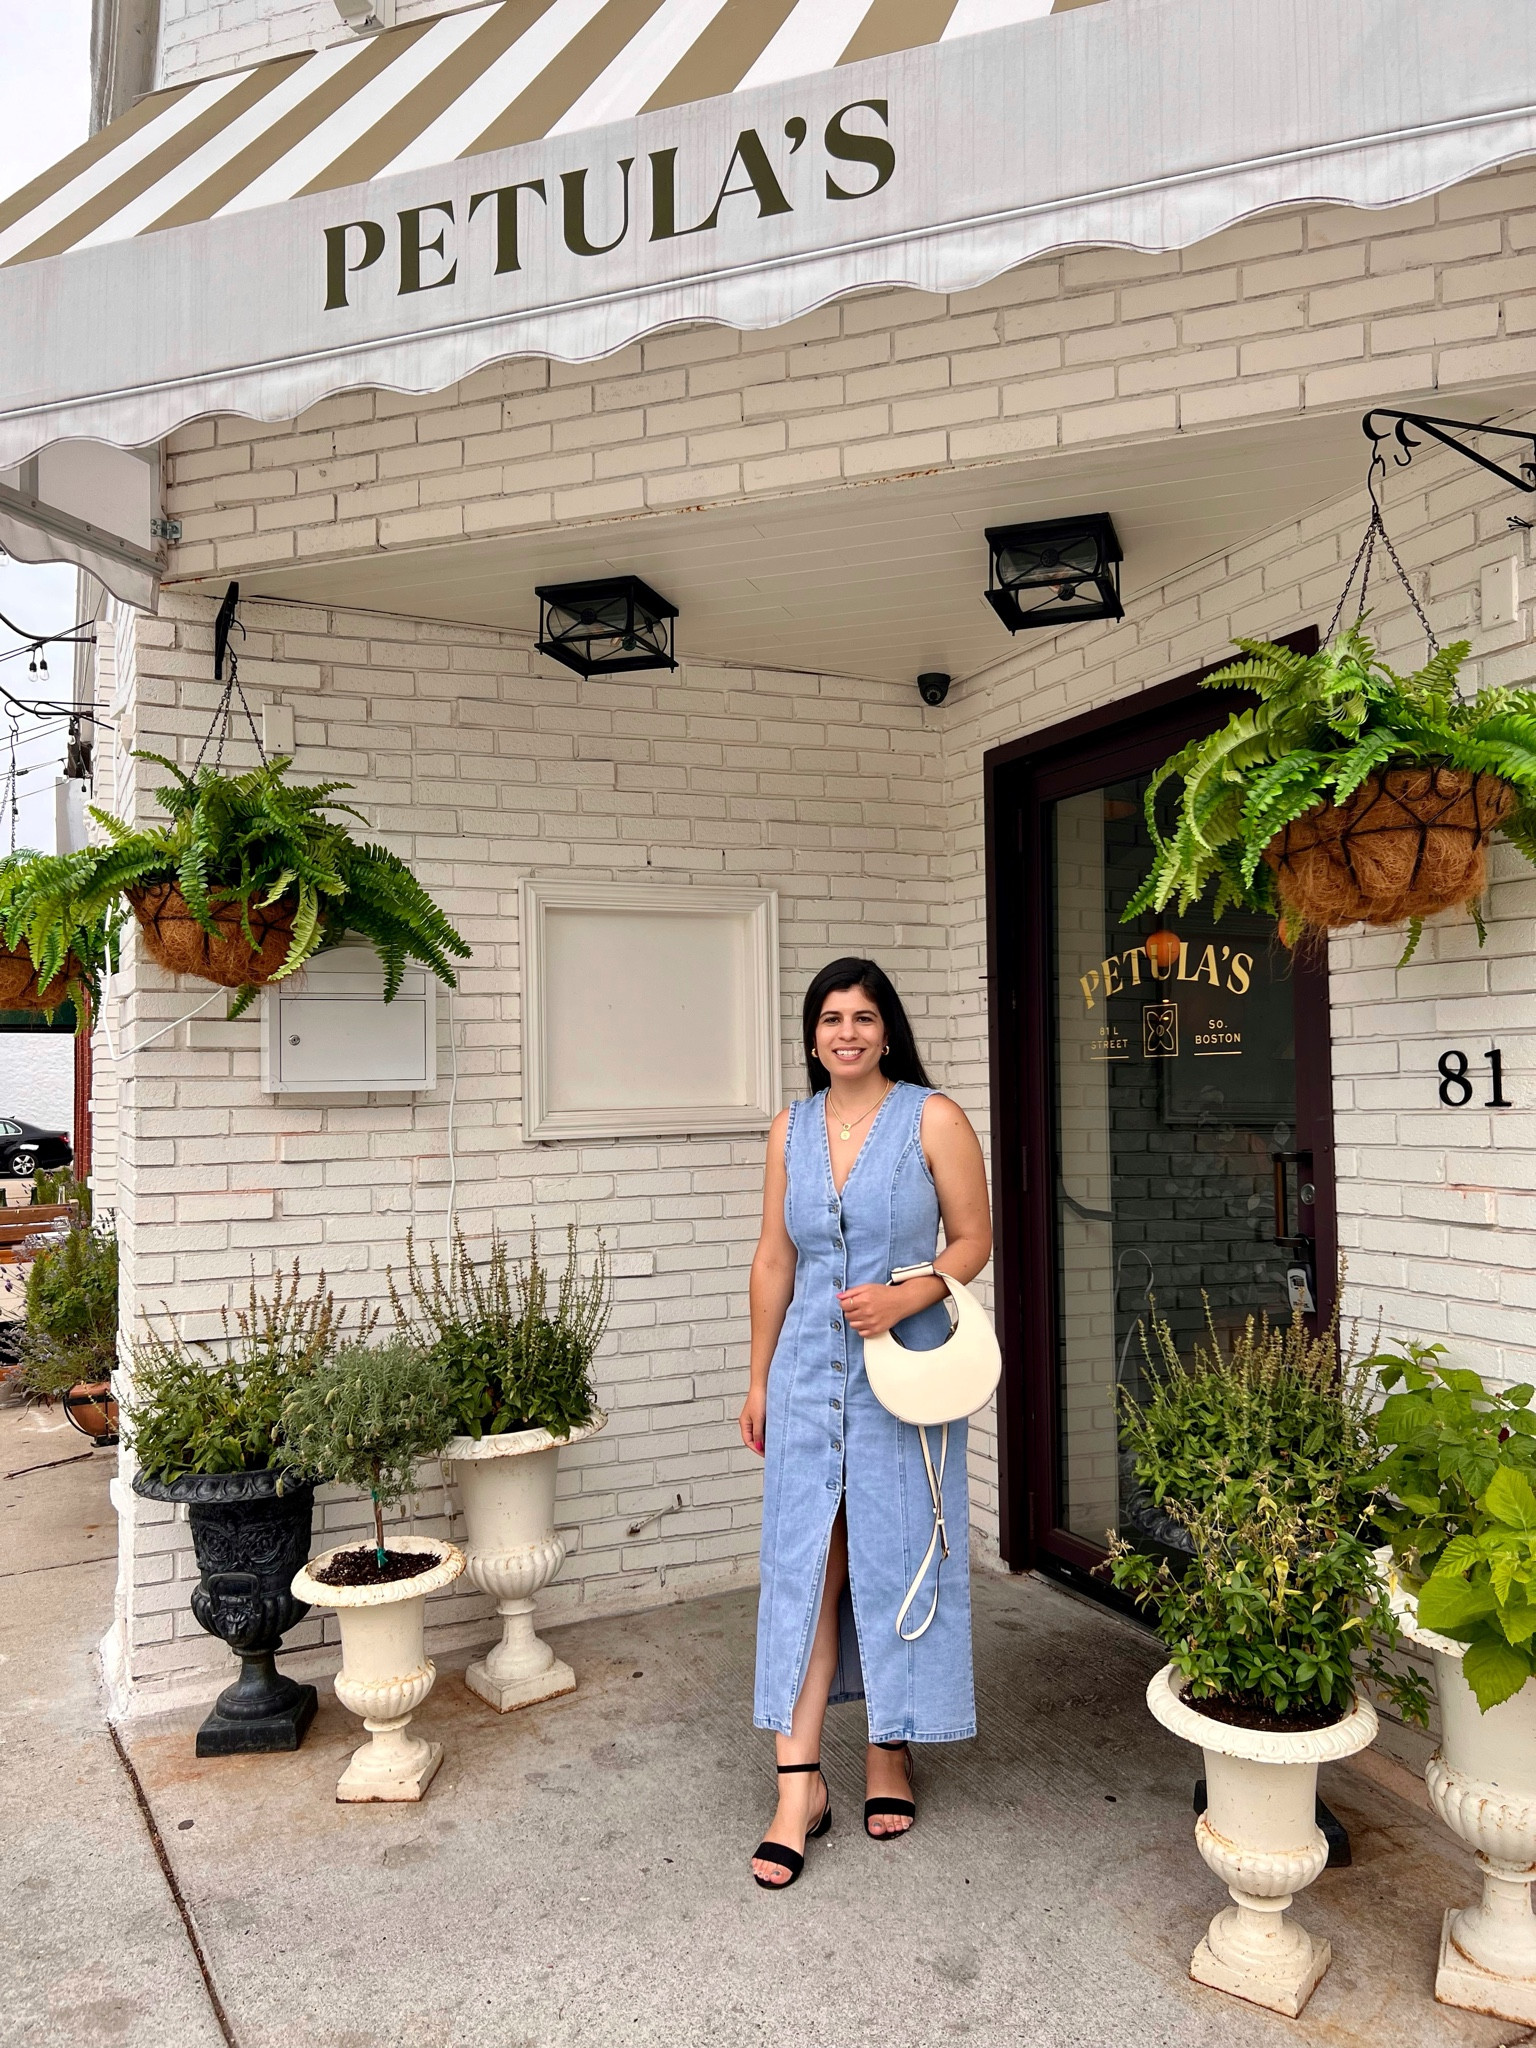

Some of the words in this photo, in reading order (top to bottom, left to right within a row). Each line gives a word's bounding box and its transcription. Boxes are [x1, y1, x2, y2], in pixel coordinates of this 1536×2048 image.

[323, 98, 897, 312] PETULA'S
[1079, 941, 1255, 1010] PETULA'S
[1099, 1026, 1110, 1036] 81
[1113, 1026, 1119, 1036] L
[1208, 1019, 1228, 1030] SO.
[1091, 1039, 1129, 1050] STREET
[1194, 1032, 1242, 1045] BOSTON
[1437, 1048, 1513, 1108] 81
